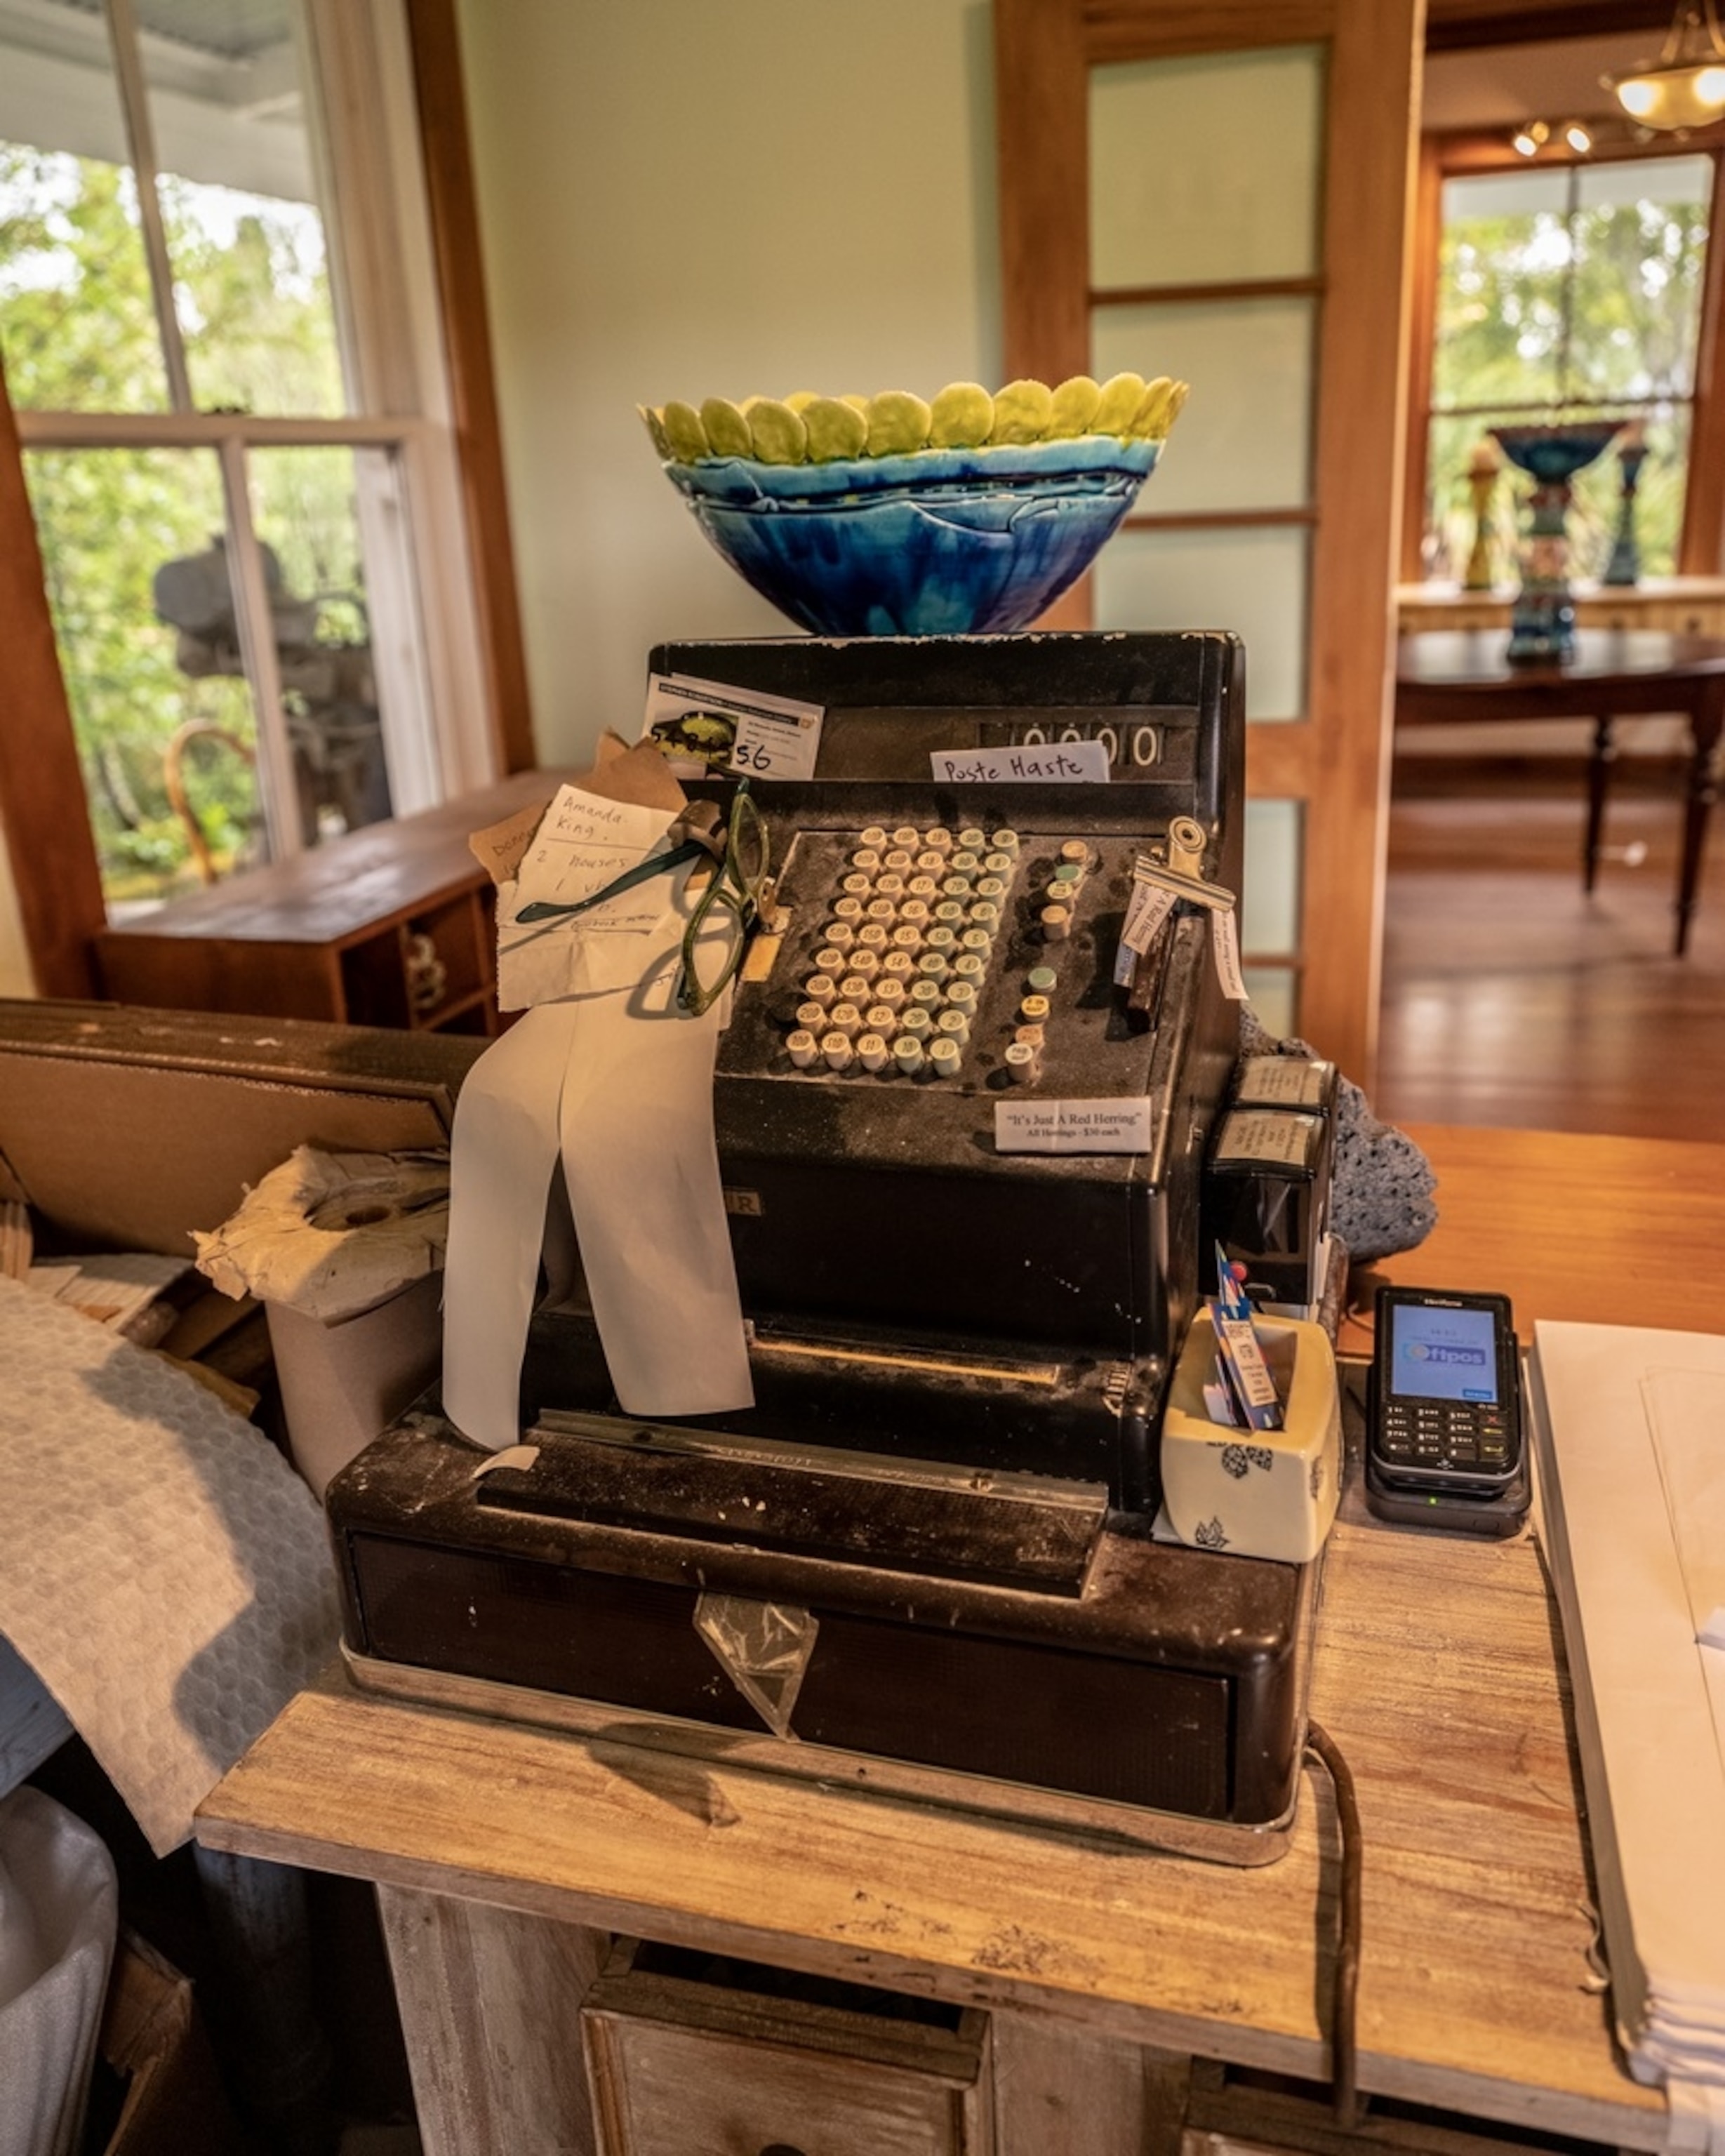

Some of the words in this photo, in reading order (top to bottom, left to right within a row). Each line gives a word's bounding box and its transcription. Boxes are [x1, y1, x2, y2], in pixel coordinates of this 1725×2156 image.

[945, 761, 1000, 781] Poste
[1011, 754, 1083, 778] Haste
[556, 816, 594, 840] King
[1006, 1114, 1031, 1126] "It's
[1034, 1114, 1053, 1126] Just
[1058, 1114, 1066, 1124] A
[1069, 1112, 1091, 1124] Red
[1093, 1111, 1143, 1126] Herring"
[1101, 1127, 1121, 1137] each
